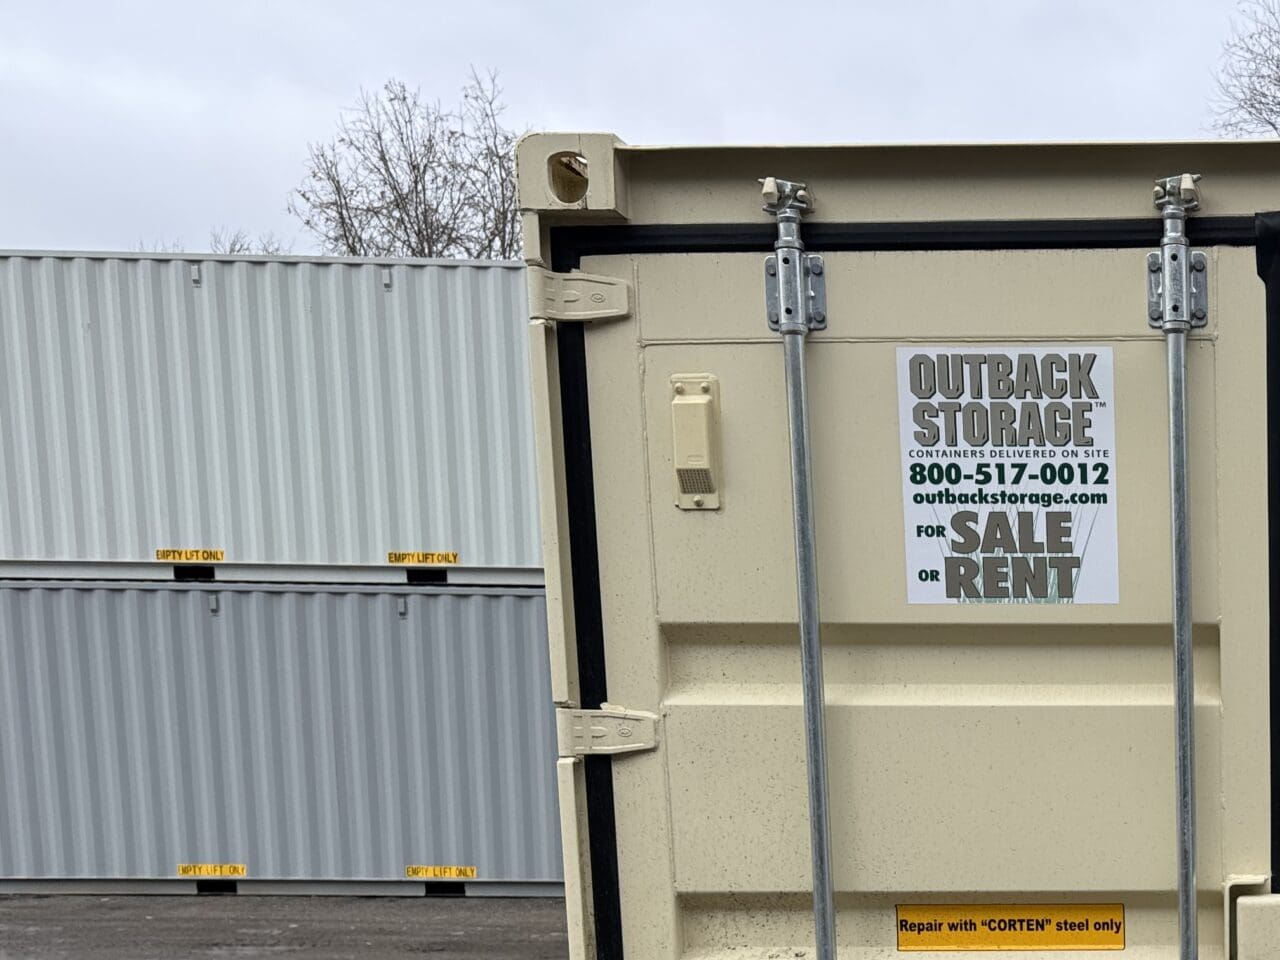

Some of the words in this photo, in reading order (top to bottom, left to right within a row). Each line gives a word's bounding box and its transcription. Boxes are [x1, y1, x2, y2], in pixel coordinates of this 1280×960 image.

[908, 353, 1099, 400] OUTBACK
[912, 401, 1094, 447] STORAGE
[908, 449, 985, 459] CONTAINERS
[989, 449, 1057, 459] DELIVERED
[1061, 449, 1079, 459] ON
[1084, 449, 1110, 459] SITE
[909, 462, 1110, 486] 800-517-0012
[912, 488, 1108, 508] outbackstorage.com
[916, 525, 946, 538] FOR
[950, 510, 1073, 554] SALE
[156, 549, 183, 561] EMPTY
[185, 549, 200, 561] LIFT
[202, 549, 225, 561] ONLY
[388, 552, 415, 564] EMPTY
[416, 552, 436, 564] LIFT
[436, 552, 458, 564] ONLY
[918, 569, 940, 582] OR
[944, 556, 1081, 599] RENT
[178, 865, 203, 876] EMPTY
[206, 865, 223, 876] LIFT
[228, 865, 246, 876] ONLY
[406, 867, 428, 878] EMPTY
[433, 867, 452, 878] LIFT
[455, 867, 475, 878] ONLY
[899, 918, 943, 935] Repair
[947, 918, 977, 932] with
[981, 918, 1052, 932] “CORTEN”
[1056, 918, 1089, 932] steel
[1093, 918, 1122, 934] only
